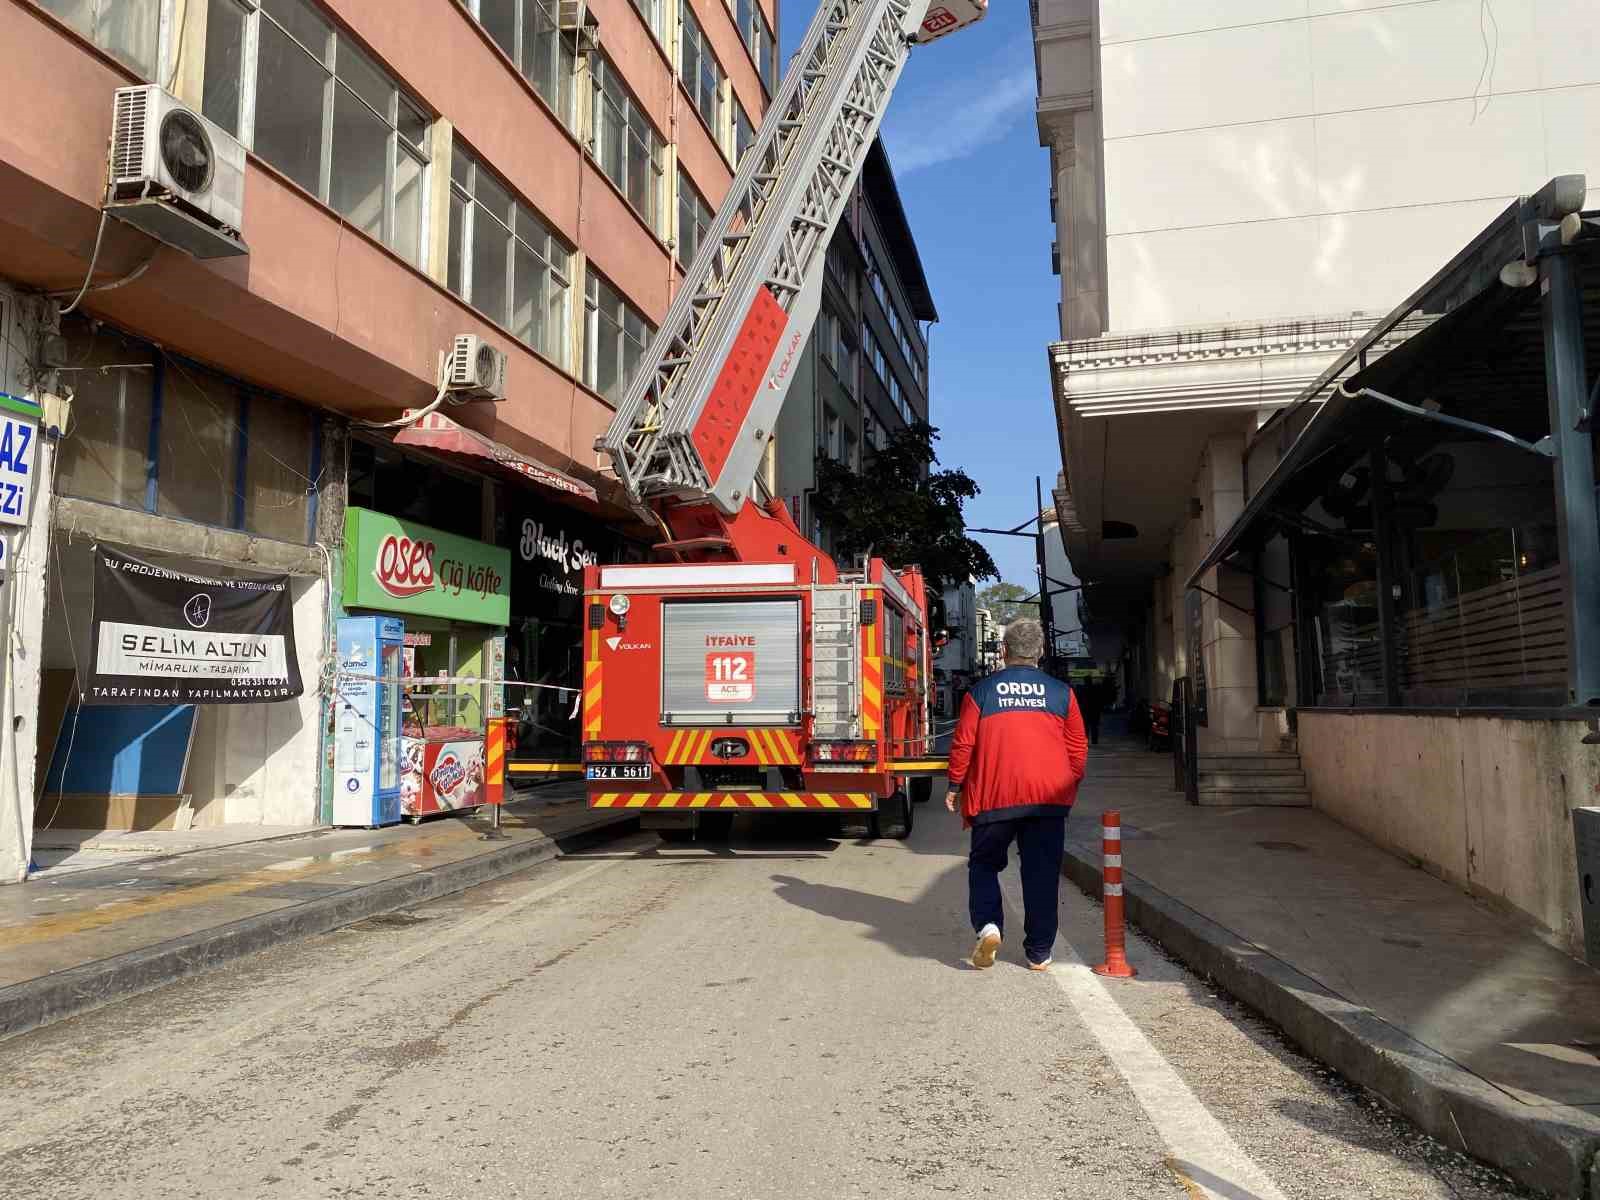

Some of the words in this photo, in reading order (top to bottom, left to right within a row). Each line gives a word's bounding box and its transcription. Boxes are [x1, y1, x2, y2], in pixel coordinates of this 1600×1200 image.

[776, 330, 803, 379] VOLKAN
[0, 421, 32, 475] AZ
[520, 518, 569, 574] Black
[104, 558, 119, 569] BU
[439, 559, 464, 596] Çiğ
[467, 562, 503, 600] köfte
[121, 634, 195, 655] SELİM
[205, 642, 267, 658] ALTUN
[705, 634, 756, 646] İTFAİYE
[138, 661, 199, 673] MİMARLIK
[712, 656, 748, 681] 112
[92, 687, 180, 698] TARAFINDAN
[996, 681, 1045, 696] ORDU
[998, 696, 1047, 708] İTFAİYESİ
[595, 766, 608, 778] 52
[610, 766, 617, 778] K
[623, 766, 648, 778] 5611
